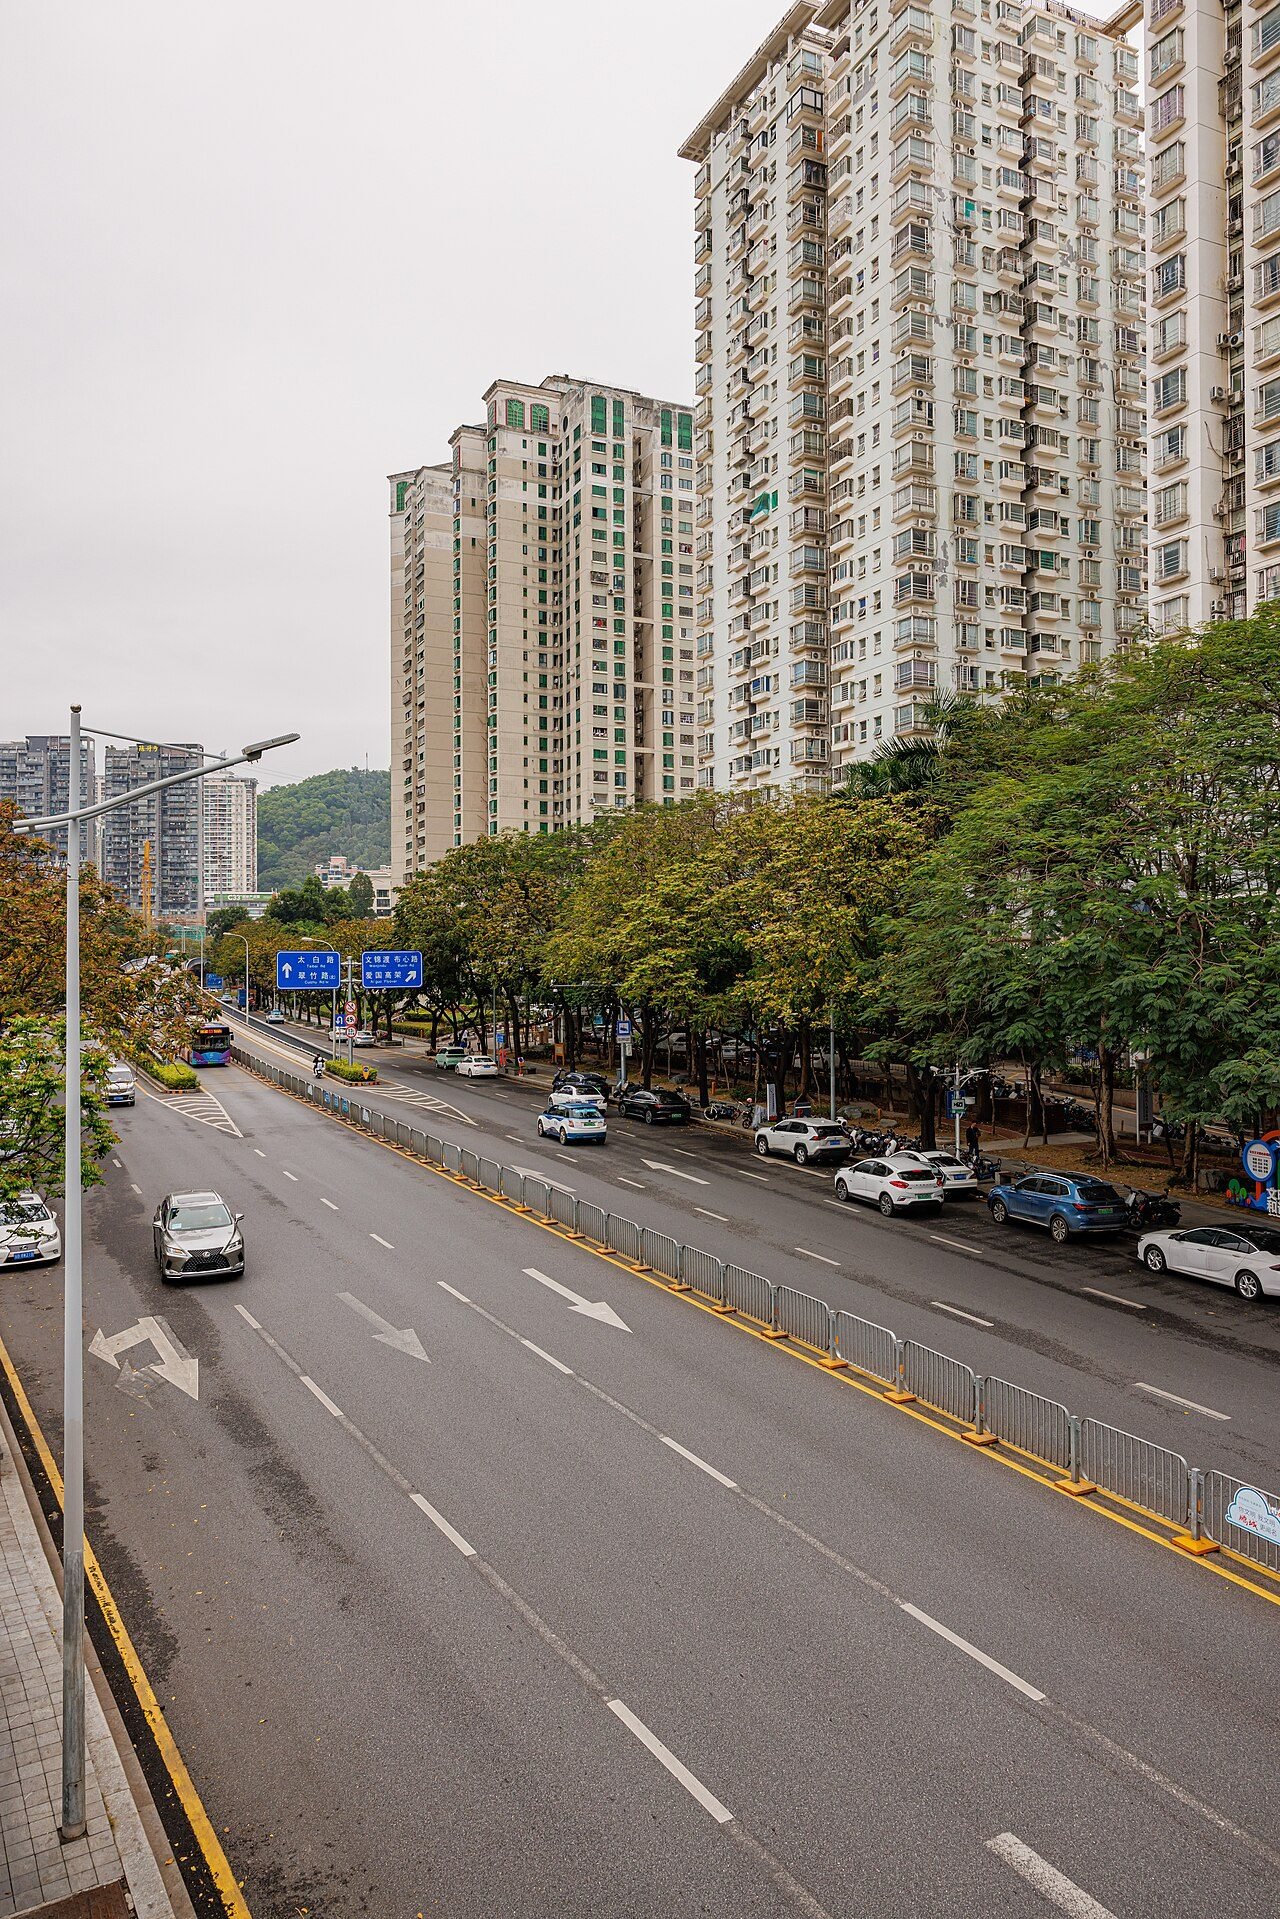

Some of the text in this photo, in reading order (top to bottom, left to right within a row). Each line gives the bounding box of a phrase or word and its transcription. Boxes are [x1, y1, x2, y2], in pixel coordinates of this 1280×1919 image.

[298, 956, 334, 964] 太白路
[394, 955, 418, 963] 布心路
